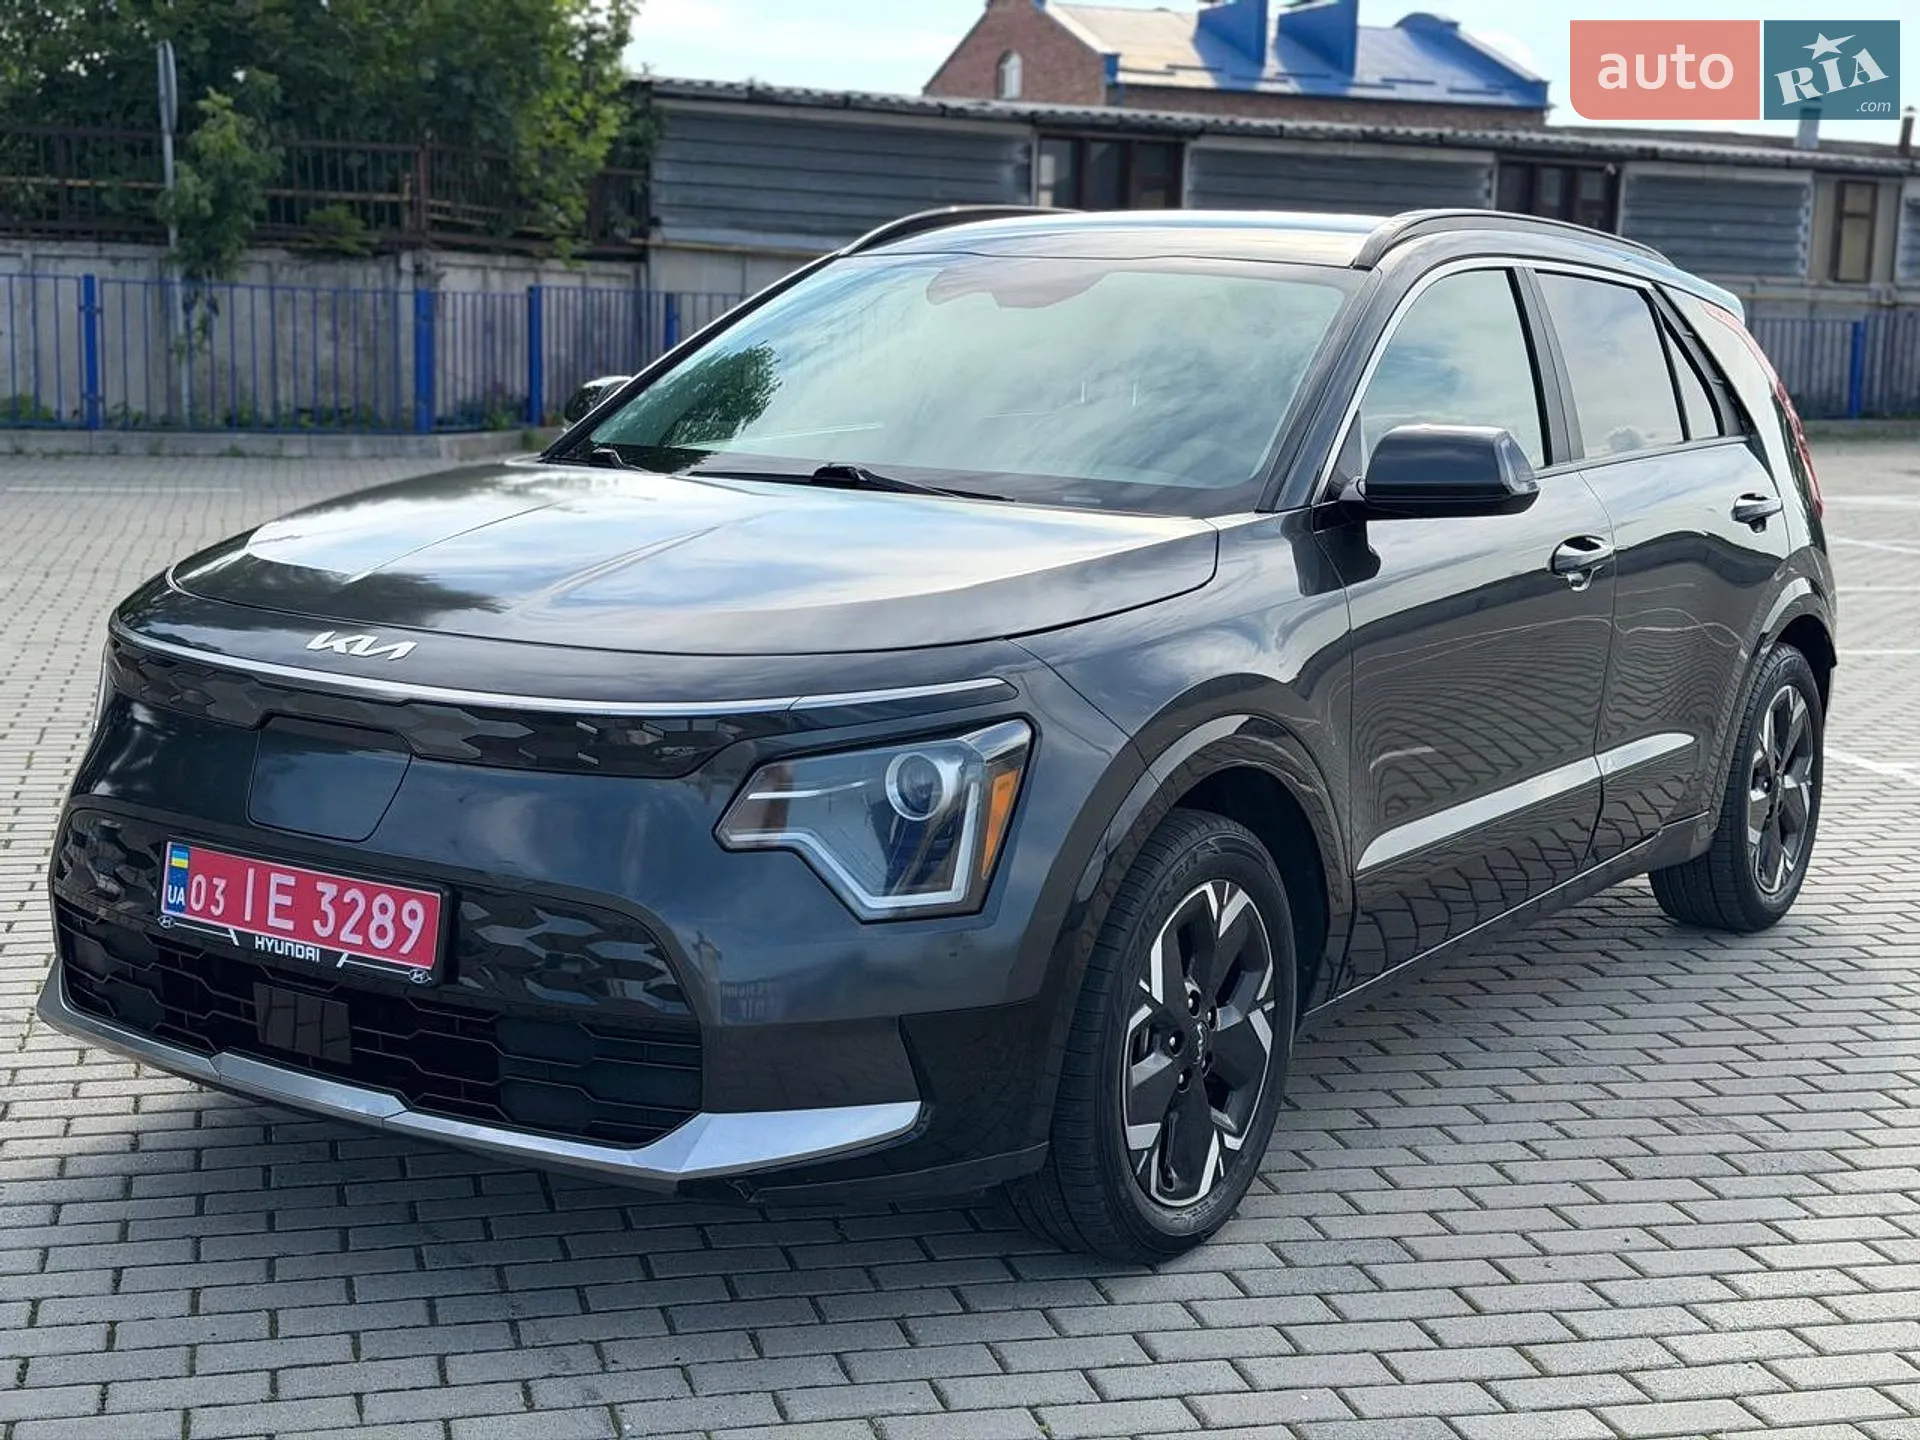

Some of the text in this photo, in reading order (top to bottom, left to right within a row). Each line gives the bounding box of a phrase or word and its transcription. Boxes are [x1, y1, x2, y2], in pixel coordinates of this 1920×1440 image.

[167, 885, 186, 906] UA
[190, 874, 227, 917] 03
[313, 882, 425, 954] 3289
[255, 935, 320, 963] HYUNDAI
